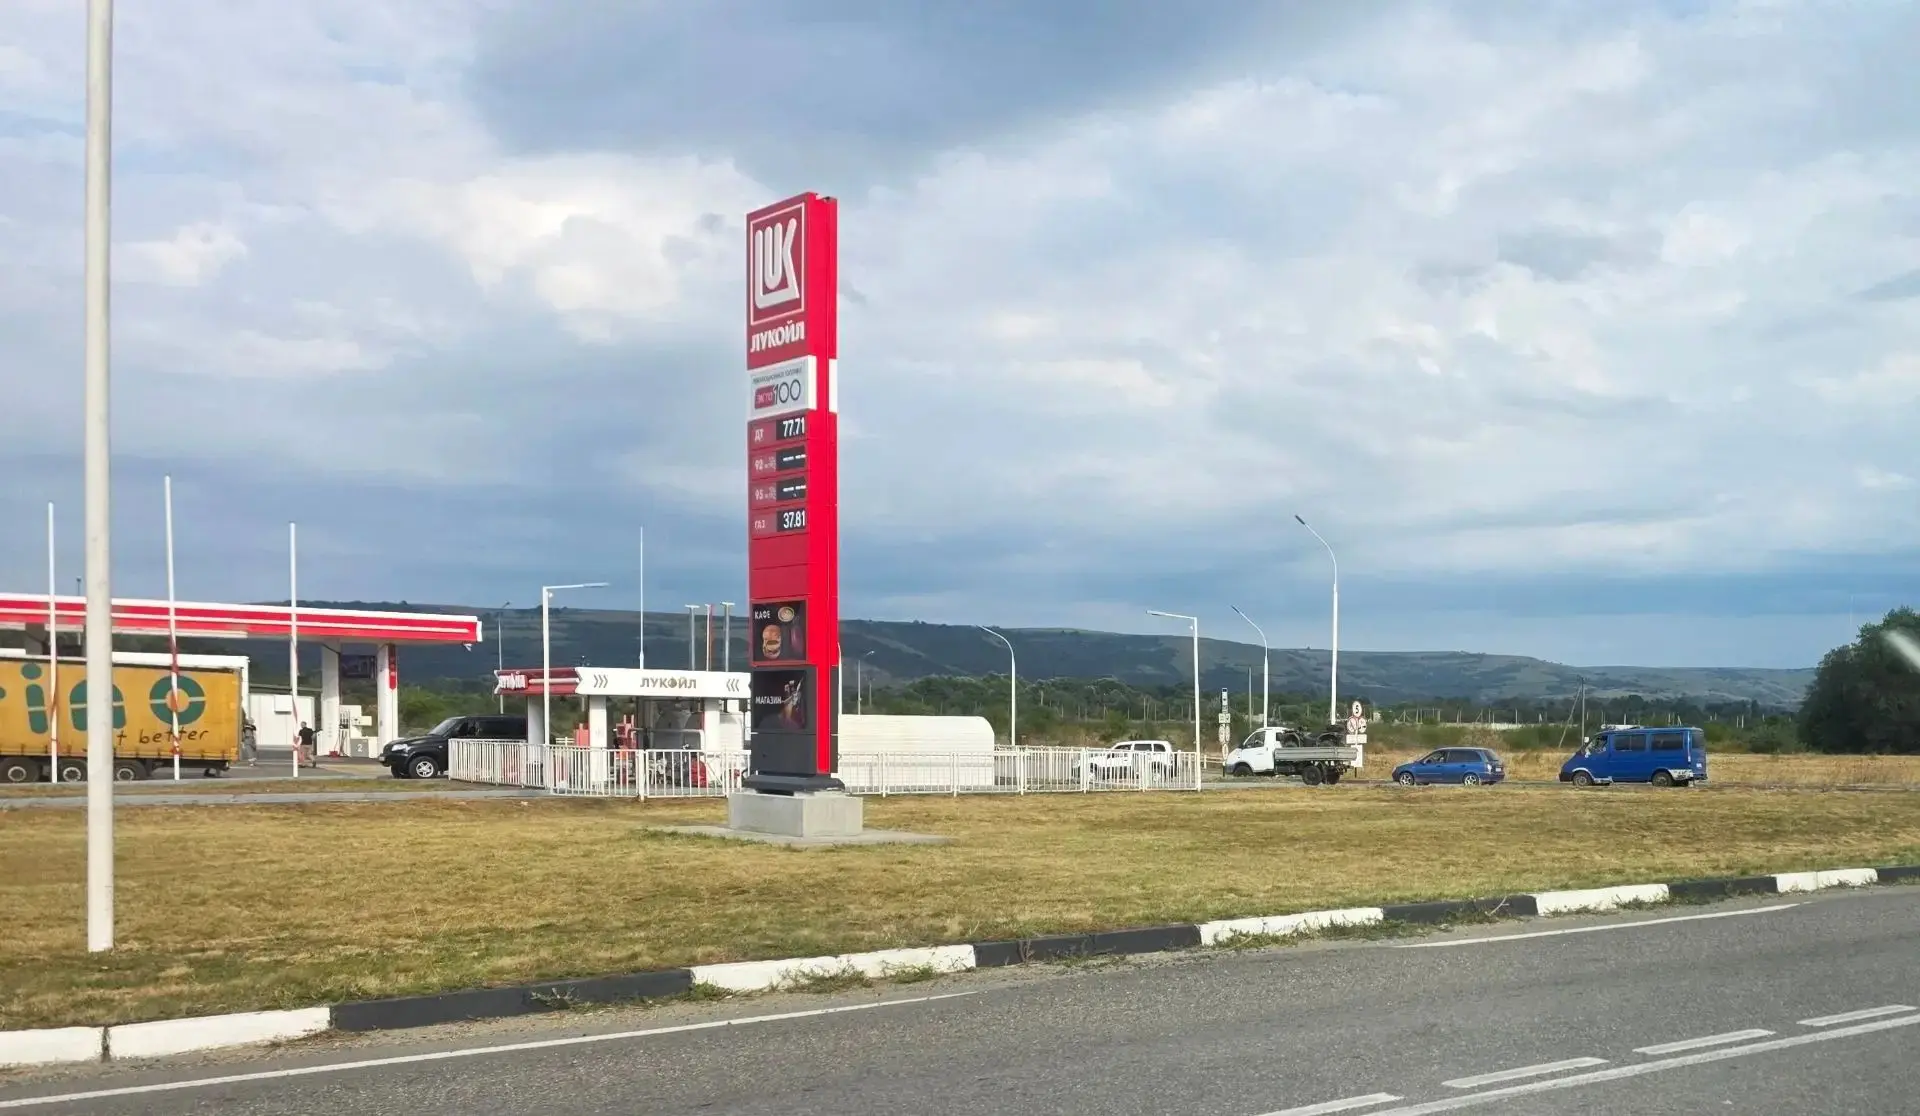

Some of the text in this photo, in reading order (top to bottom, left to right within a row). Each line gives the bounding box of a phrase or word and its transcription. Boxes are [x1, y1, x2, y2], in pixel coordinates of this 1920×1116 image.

[750, 320, 805, 353] ЛУКОЙЛ
[773, 378, 802, 405] 100
[783, 417, 805, 437] 77.71
[754, 428, 764, 442] ДТ
[754, 488, 764, 501] 95
[783, 510, 806, 529] 37.81
[754, 610, 771, 619] КАФЕ
[639, 676, 697, 689] ЛУКОЙЛ
[755, 695, 782, 705] МАГАЗИН
[139, 726, 209, 744] better
[357, 744, 363, 753] 2
